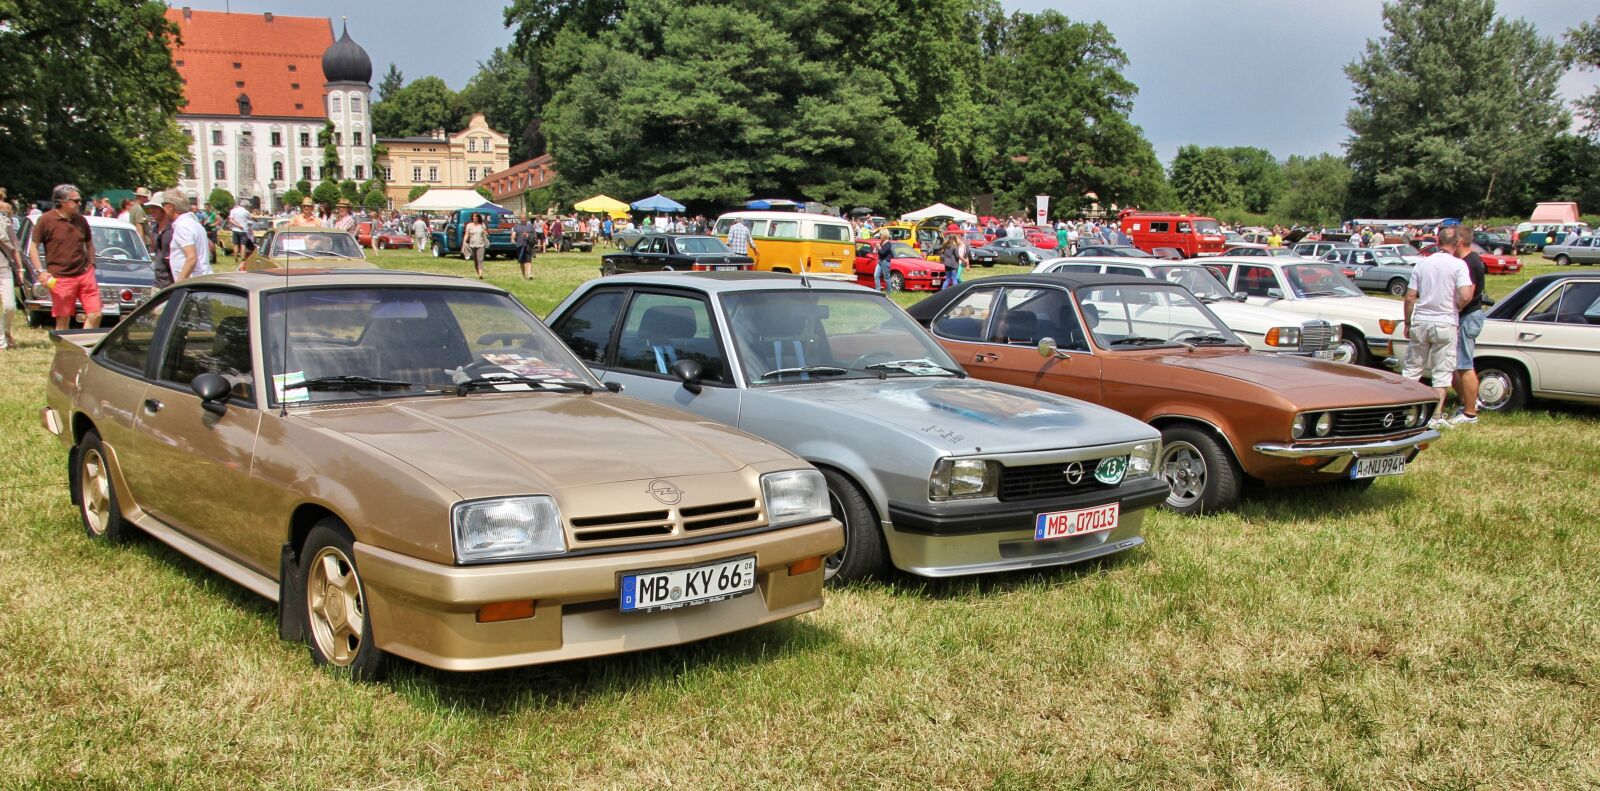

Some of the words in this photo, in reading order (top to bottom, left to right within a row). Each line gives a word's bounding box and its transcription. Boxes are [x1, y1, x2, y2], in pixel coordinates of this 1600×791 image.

[1106, 460, 1117, 475] 13
[1357, 460, 1363, 475] A
[1368, 459, 1381, 475] NU
[1382, 457, 1405, 473] 994H
[1048, 515, 1068, 535] MB
[1077, 507, 1115, 531] 07013
[744, 561, 753, 570] 06
[639, 576, 669, 603] MB
[685, 569, 714, 597] KY
[718, 564, 742, 590] 66
[625, 595, 632, 604] D
